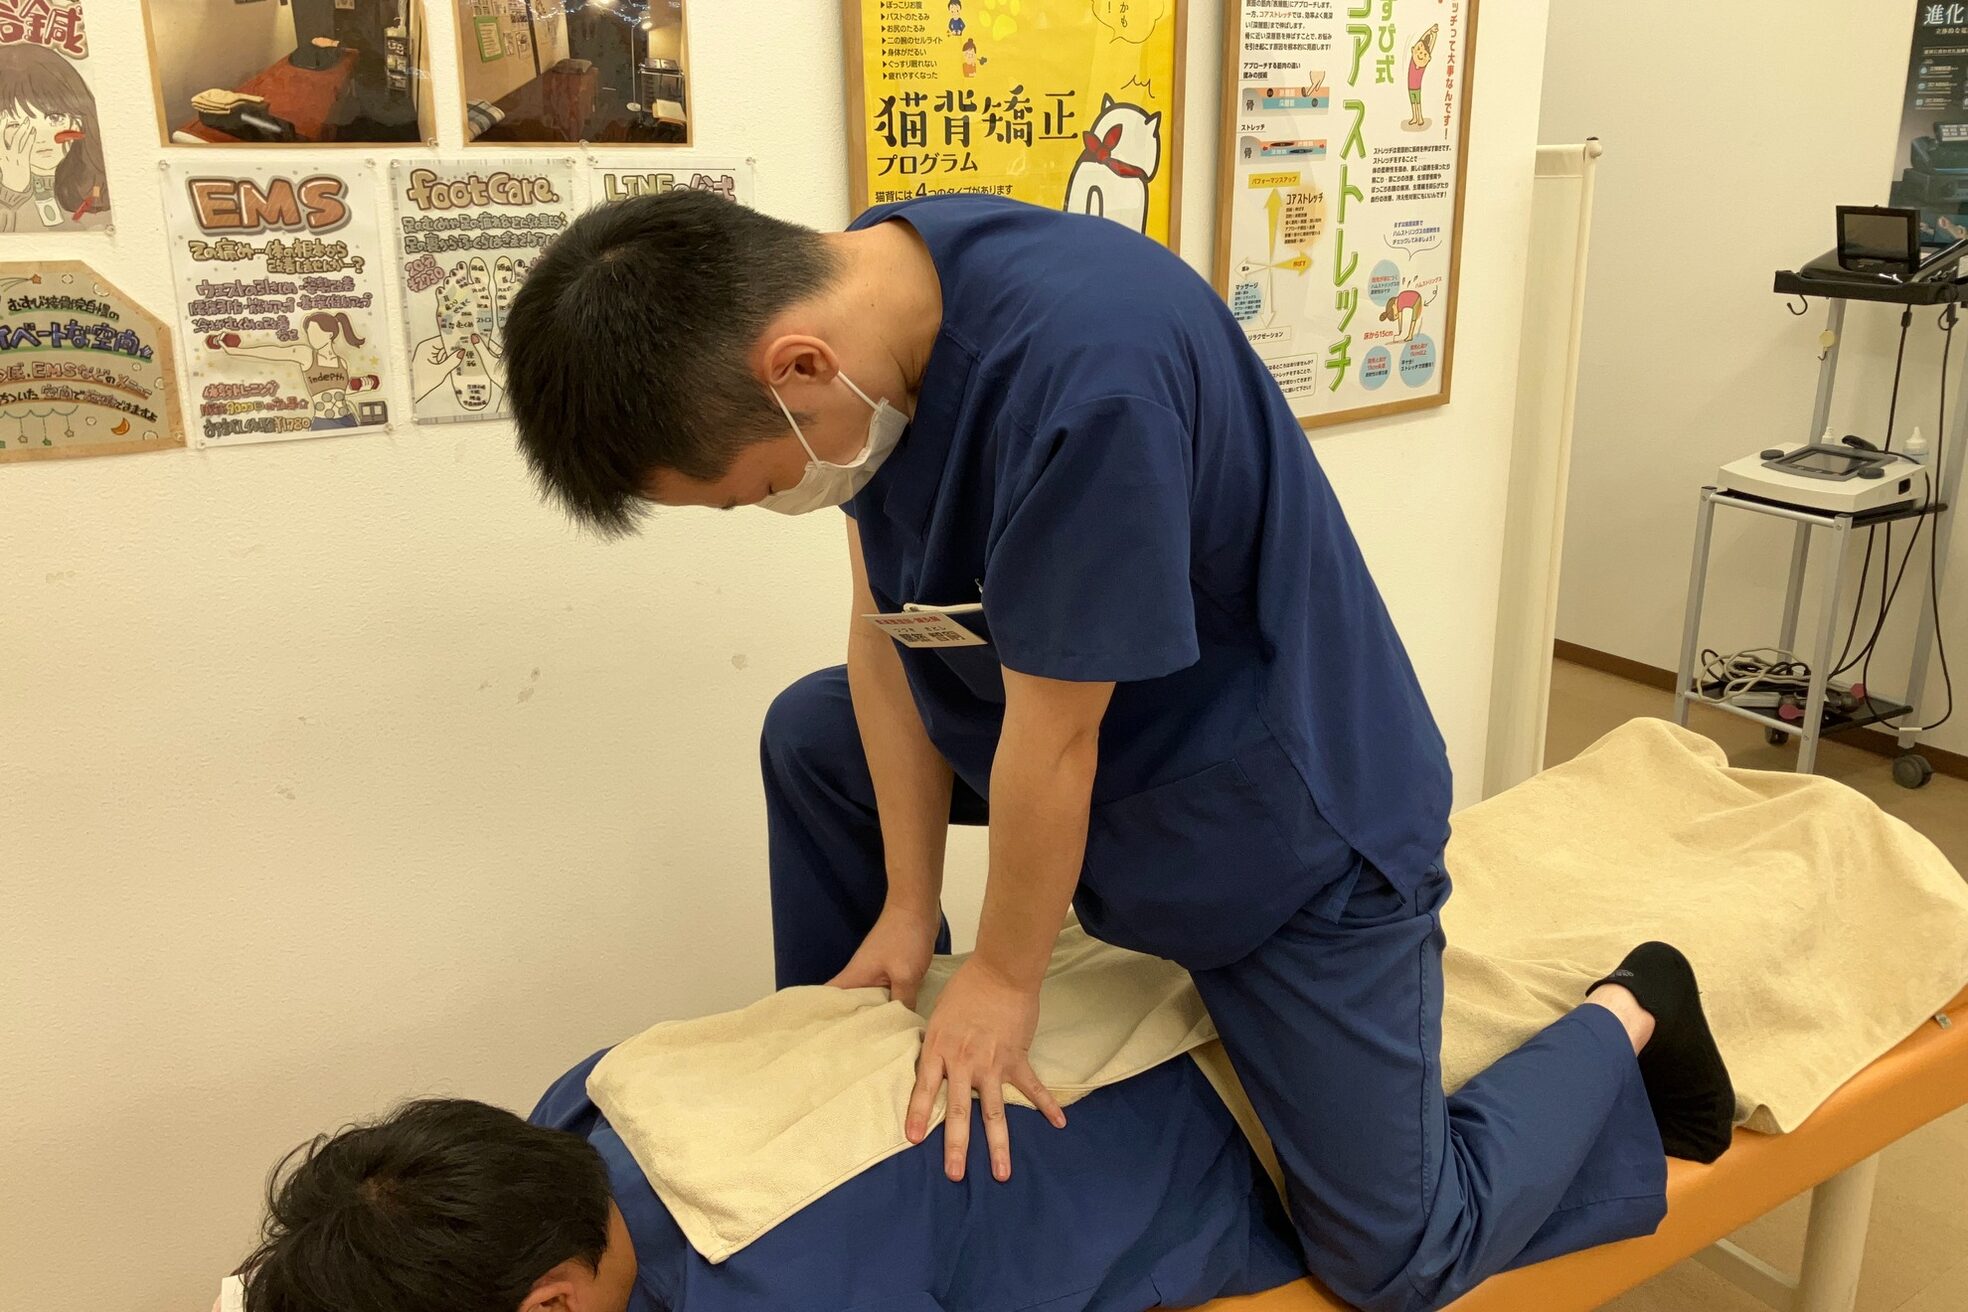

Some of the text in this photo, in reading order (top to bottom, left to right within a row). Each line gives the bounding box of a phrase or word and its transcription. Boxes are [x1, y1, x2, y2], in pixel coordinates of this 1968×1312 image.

[886, 13, 930, 21] バストのたるみ
[1923, 3, 1964, 26] 進化
[887, 25, 926, 33] お尻のたるみ
[887, 37, 943, 45] 二の腕のセルライト
[888, 60, 938, 68] ぐっすり眠れない
[888, 72, 938, 80] 疲れやすくなった
[874, 84, 1079, 148] 猫背矯正
[1241, 124, 1266, 132] ストレッチ
[877, 151, 979, 176] プログラム
[1251, 175, 1297, 185] パフォーマンスアップ
[1286, 191, 1324, 206] コアストレッチ
[187, 176, 348, 232] EMS
[1235, 282, 1259, 290] マッサージ
[308, 370, 346, 385] indepth
